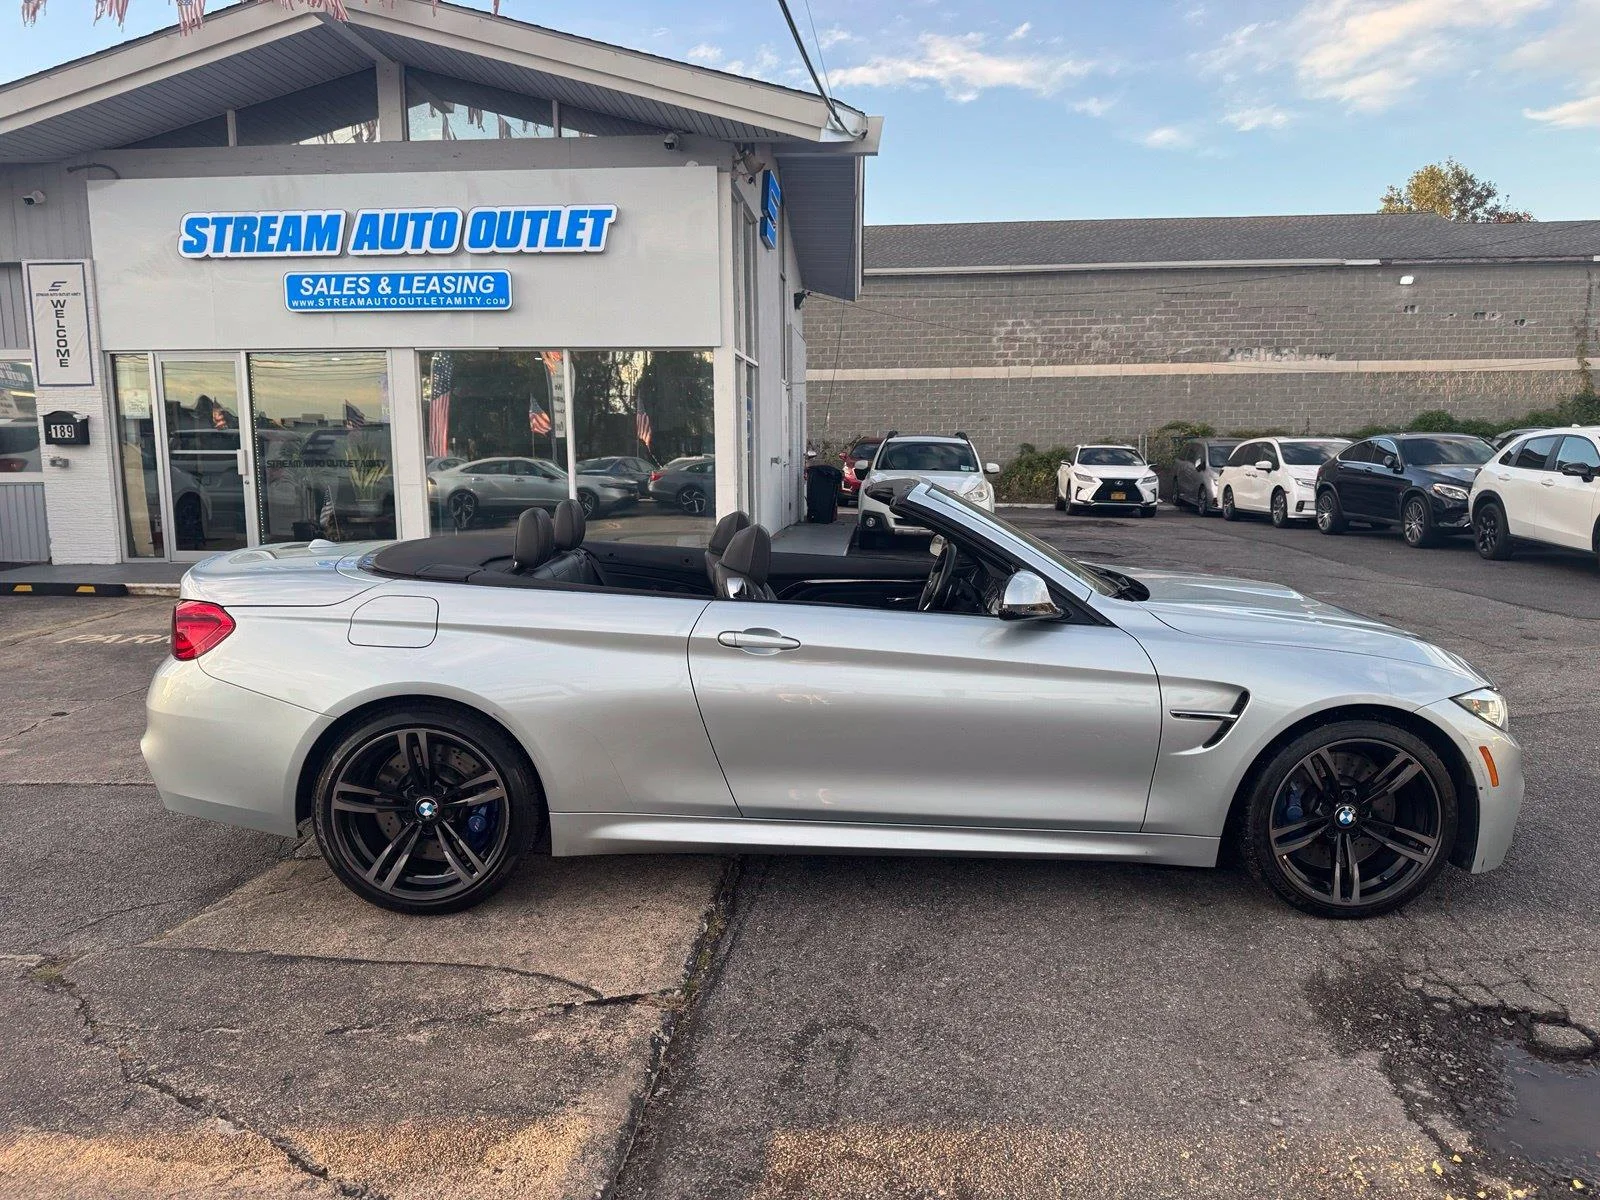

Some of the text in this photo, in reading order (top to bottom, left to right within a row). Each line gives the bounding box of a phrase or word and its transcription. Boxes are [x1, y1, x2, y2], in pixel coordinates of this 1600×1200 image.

[182, 209, 613, 254] STREAM AUTO OUTLET
[300, 275, 495, 296] SALES & LEASING
[50, 299, 70, 368] WELCOME
[52, 425, 73, 438] 189
